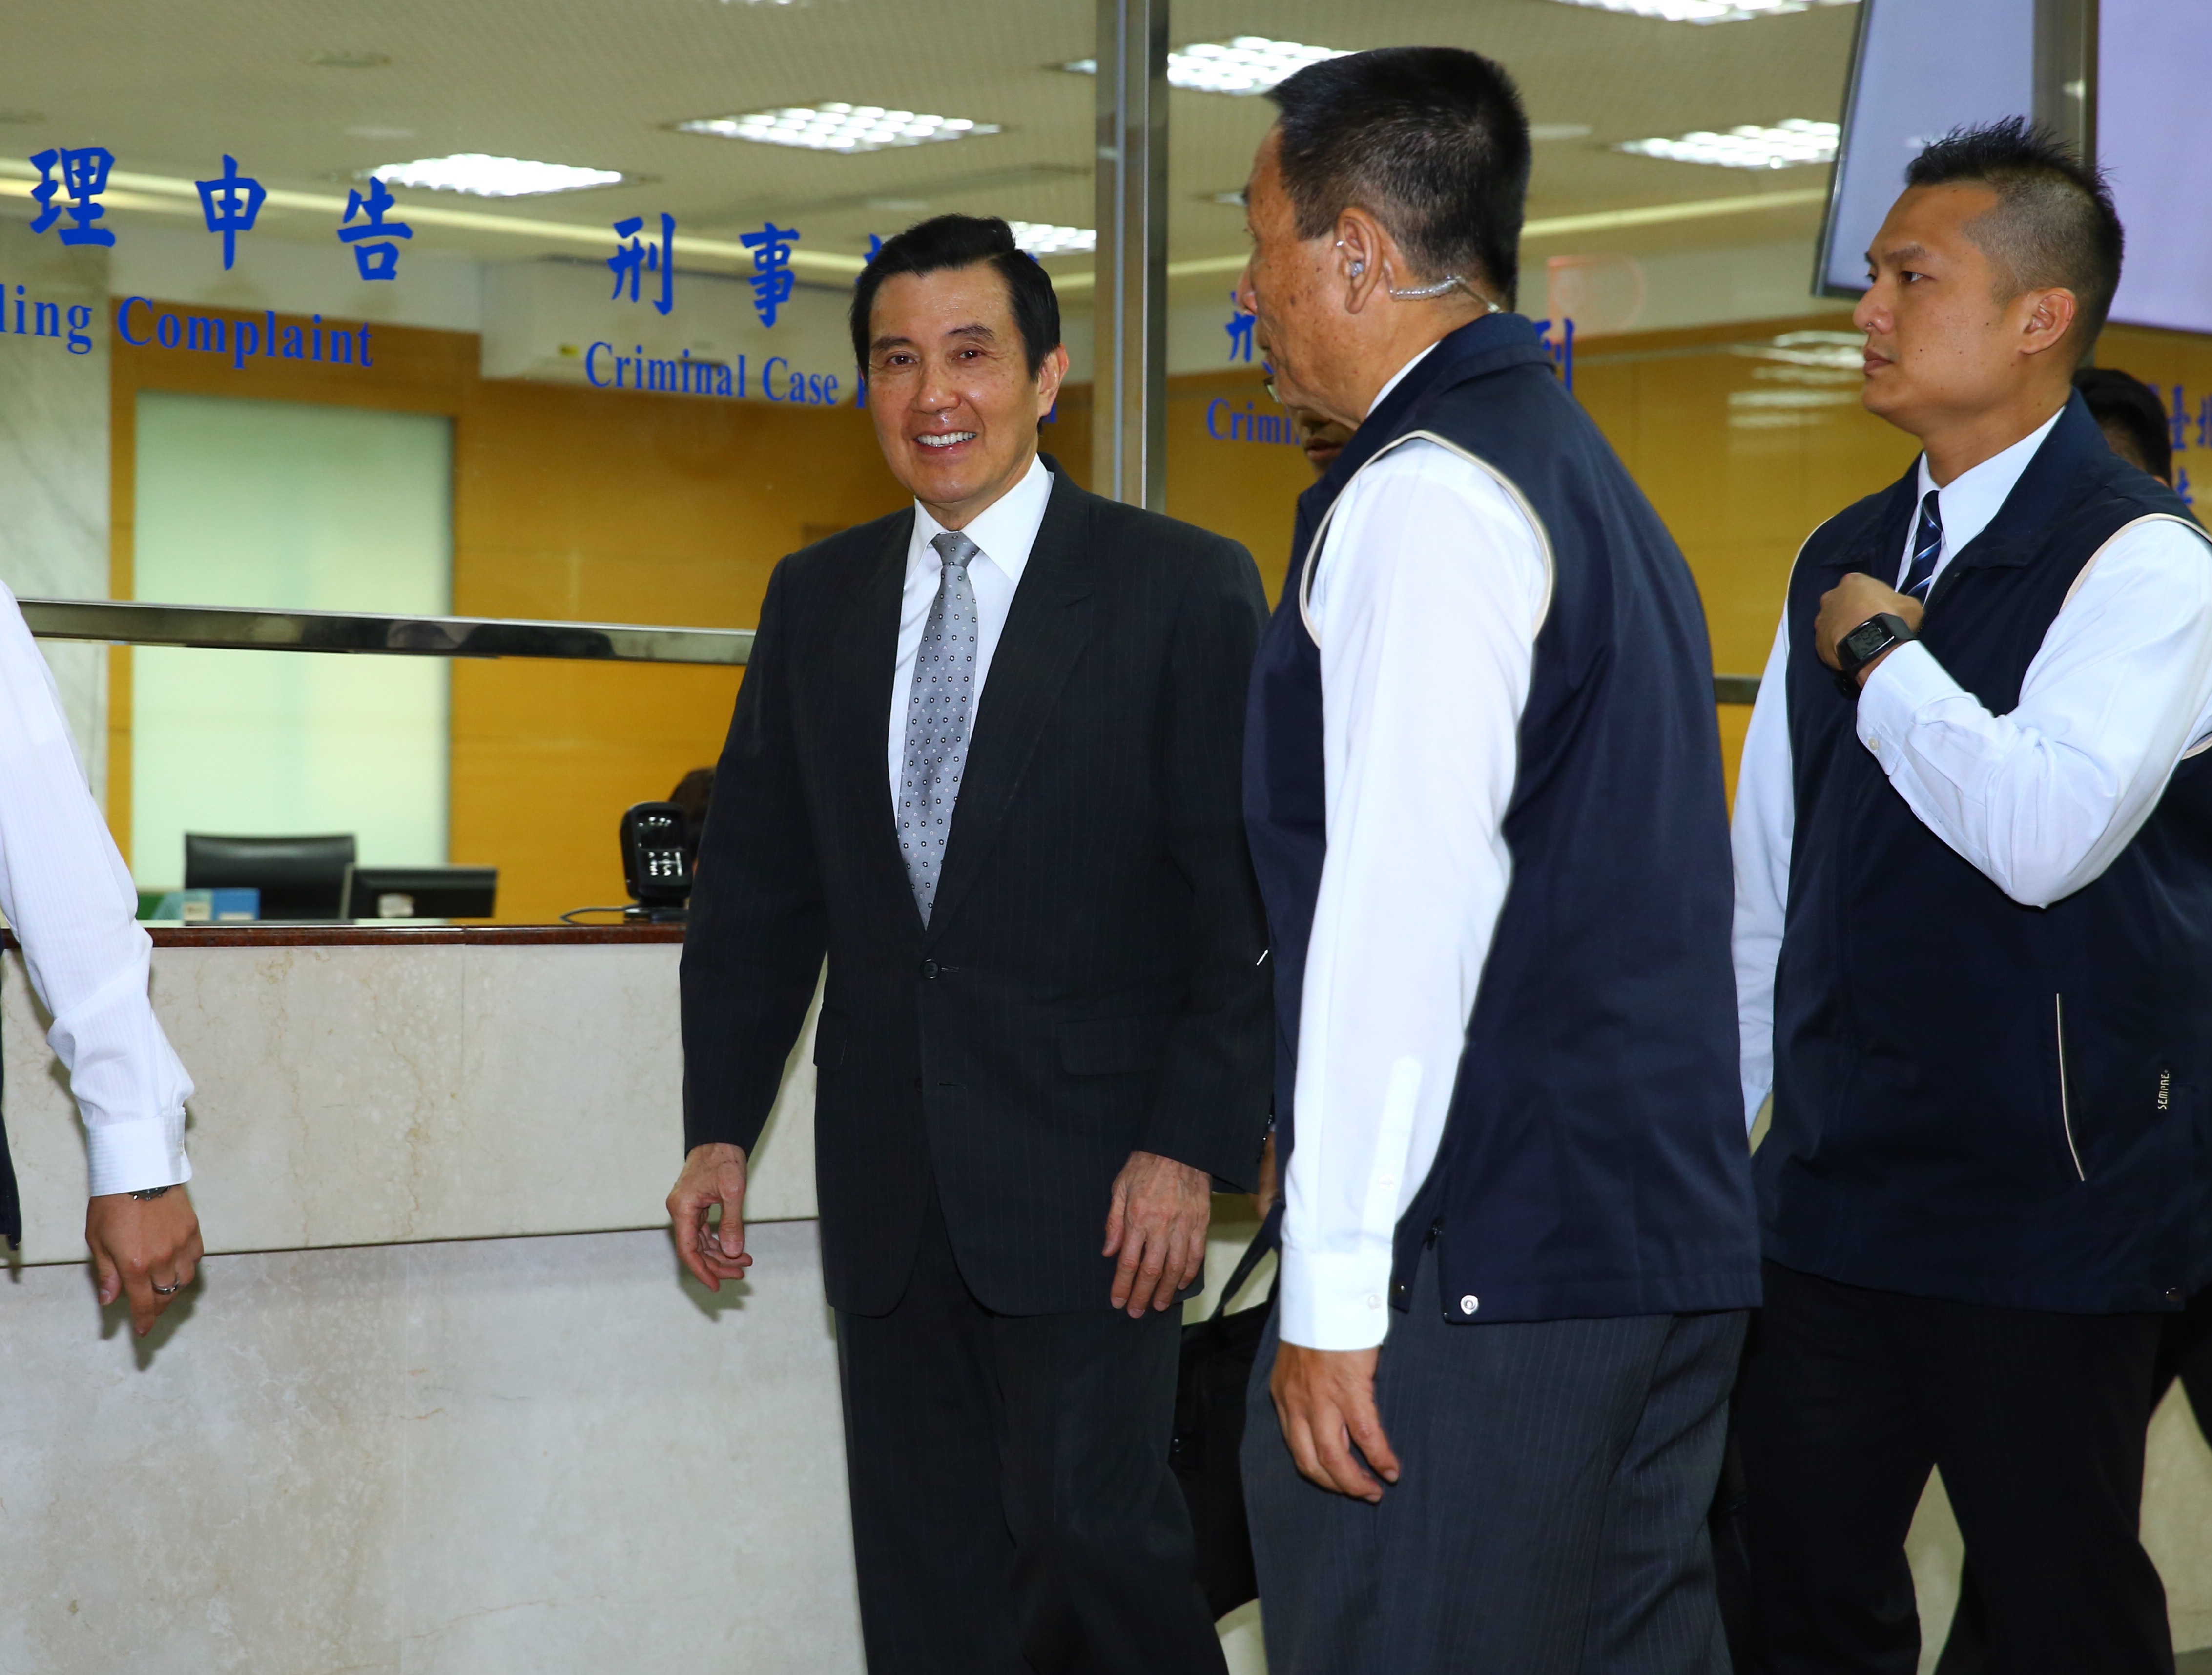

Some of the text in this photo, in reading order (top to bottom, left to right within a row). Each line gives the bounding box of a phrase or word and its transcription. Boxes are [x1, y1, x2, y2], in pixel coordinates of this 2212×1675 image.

[29, 147, 413, 281] 理申告
[606, 212, 882, 329] 刑事
[117, 296, 373, 369] Complaint
[585, 341, 746, 398] Criminal
[762, 357, 839, 406] Case
[1206, 397, 1300, 445] Crimi
[2157, 1073, 2170, 1110] SEMPRE
